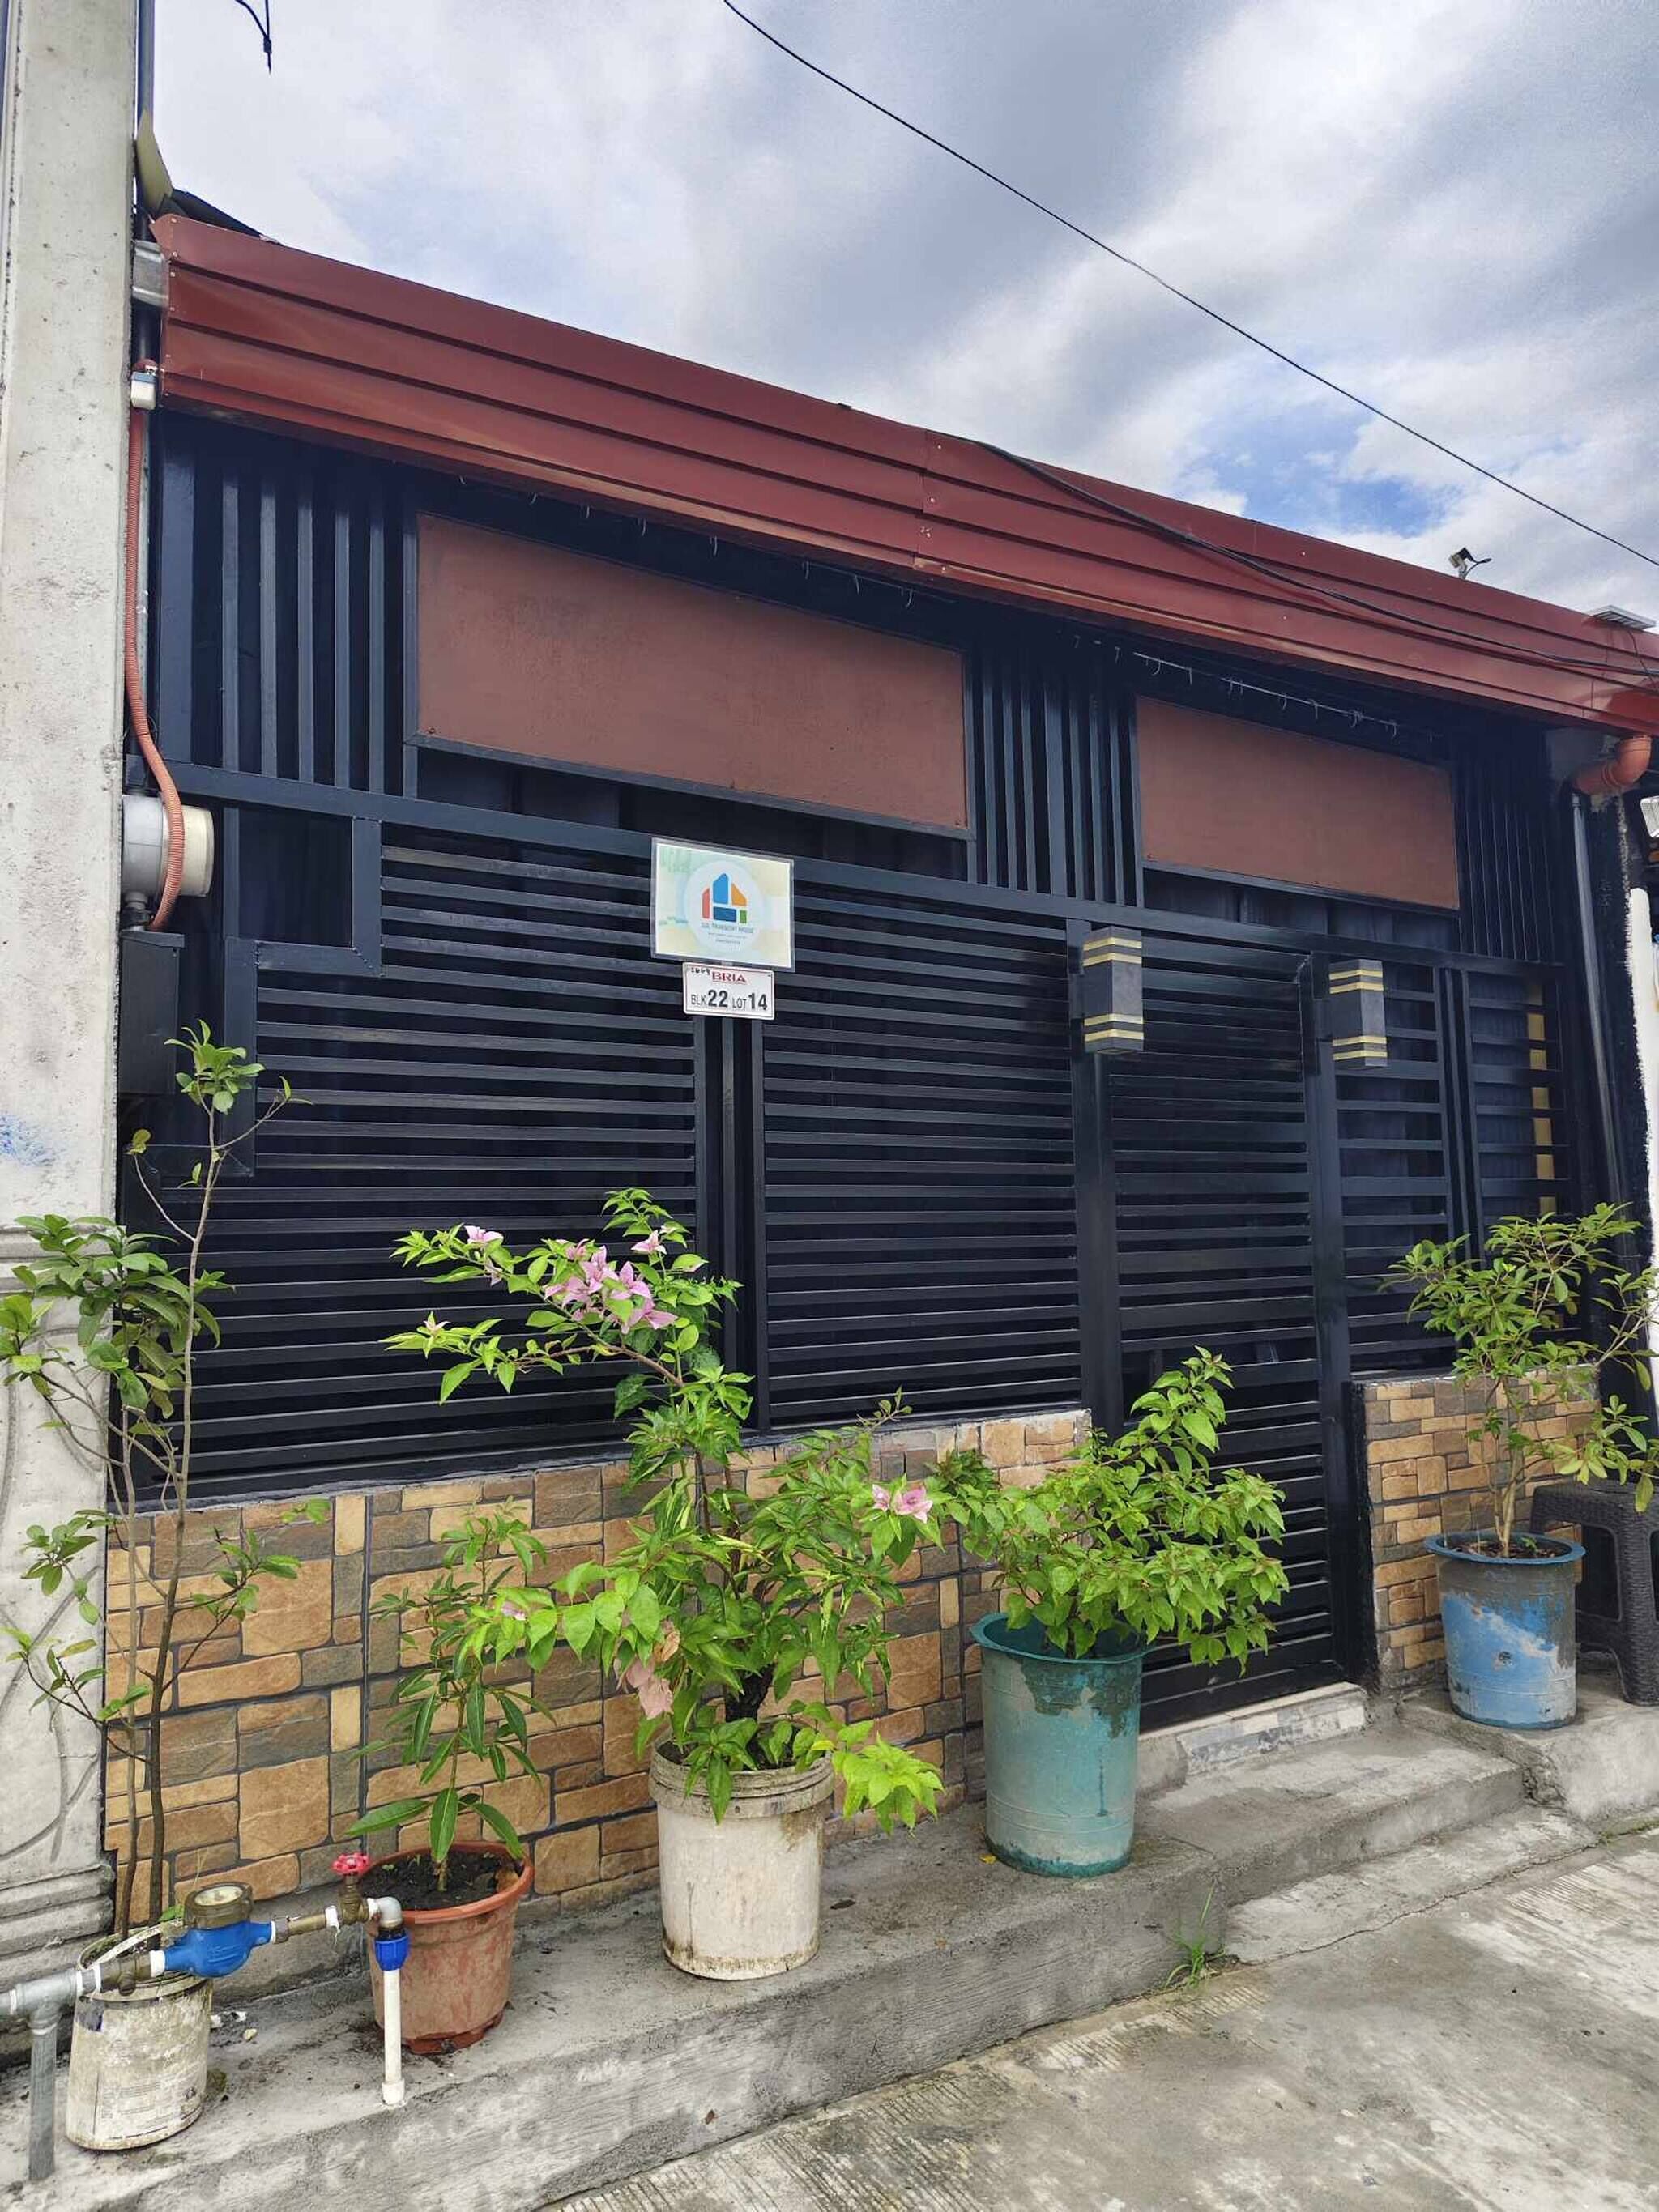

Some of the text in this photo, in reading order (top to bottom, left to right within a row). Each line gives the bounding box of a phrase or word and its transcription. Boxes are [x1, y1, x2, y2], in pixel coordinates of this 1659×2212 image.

[712, 972, 746, 982] BRIA
[691, 990, 767, 1010] BLK 22 LOT 14
